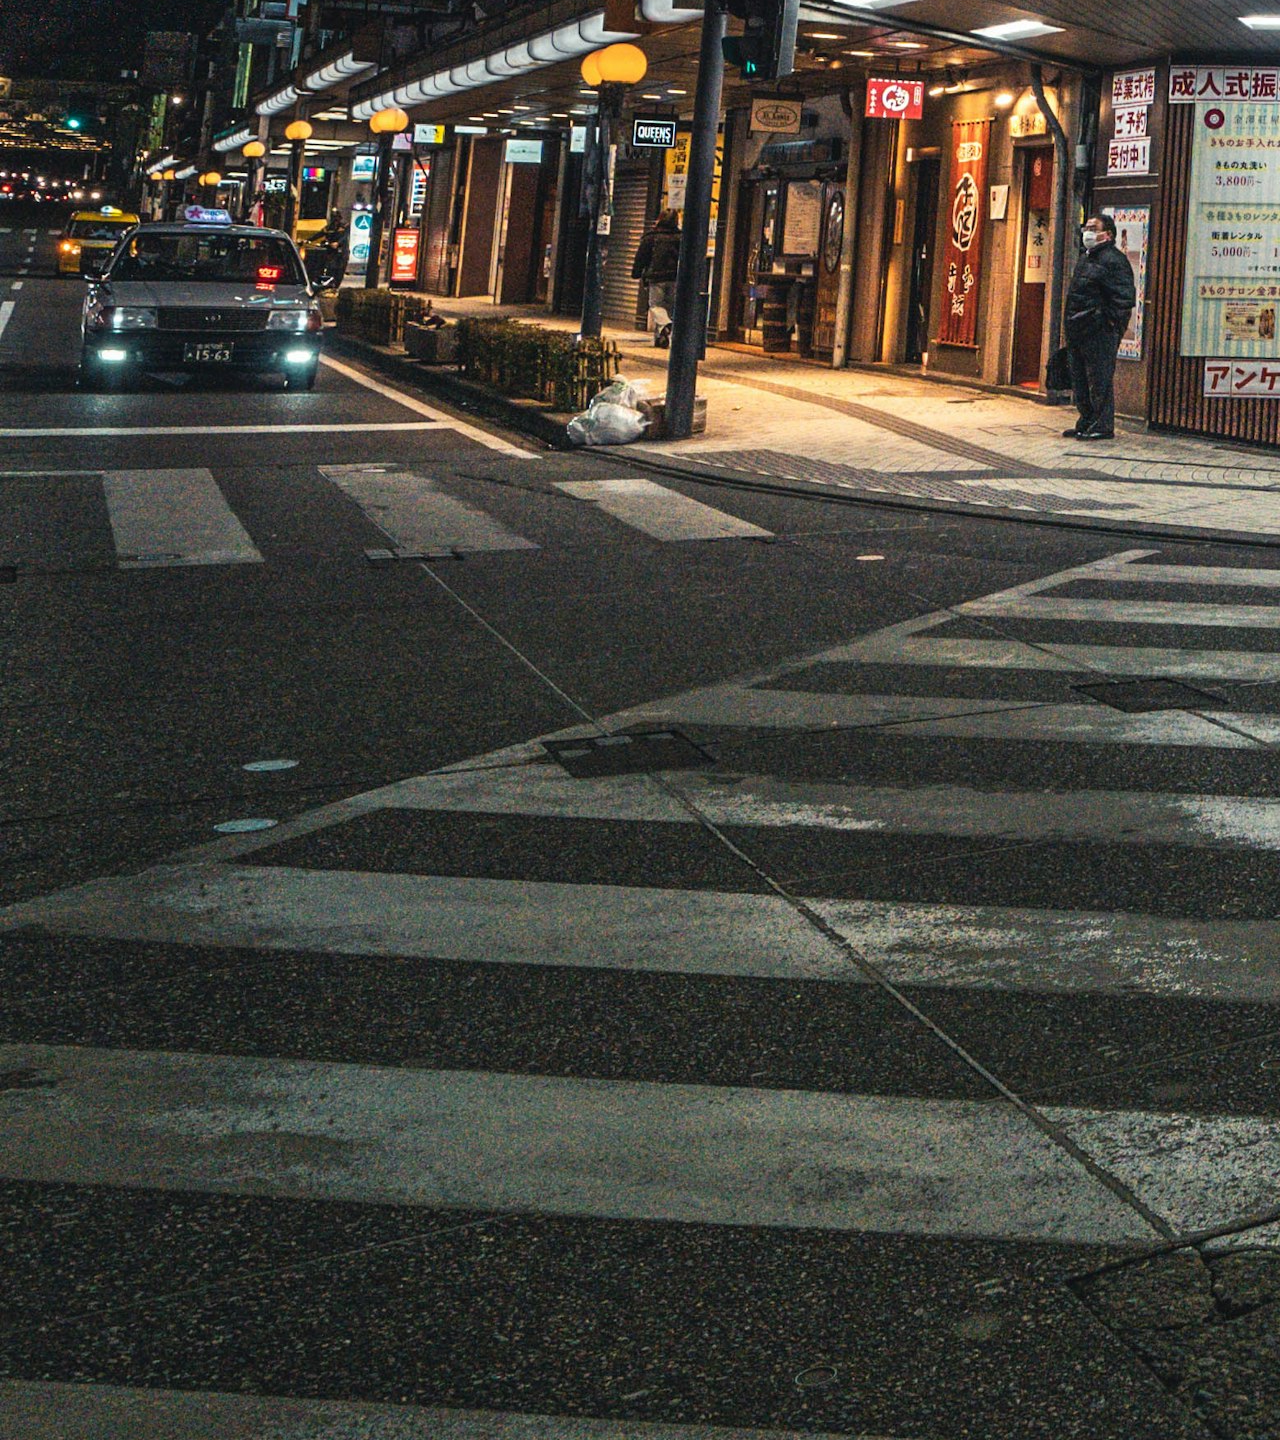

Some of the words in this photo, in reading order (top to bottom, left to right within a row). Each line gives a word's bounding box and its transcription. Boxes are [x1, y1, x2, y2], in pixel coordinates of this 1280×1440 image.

[1113, 73, 1155, 101] 卒業式袴
[637, 125, 672, 140] QUEENS
[1115, 110, 1147, 135] ご予約
[1108, 143, 1147, 170] 受付中!
[1214, 160, 1268, 171] きもの丸洗い
